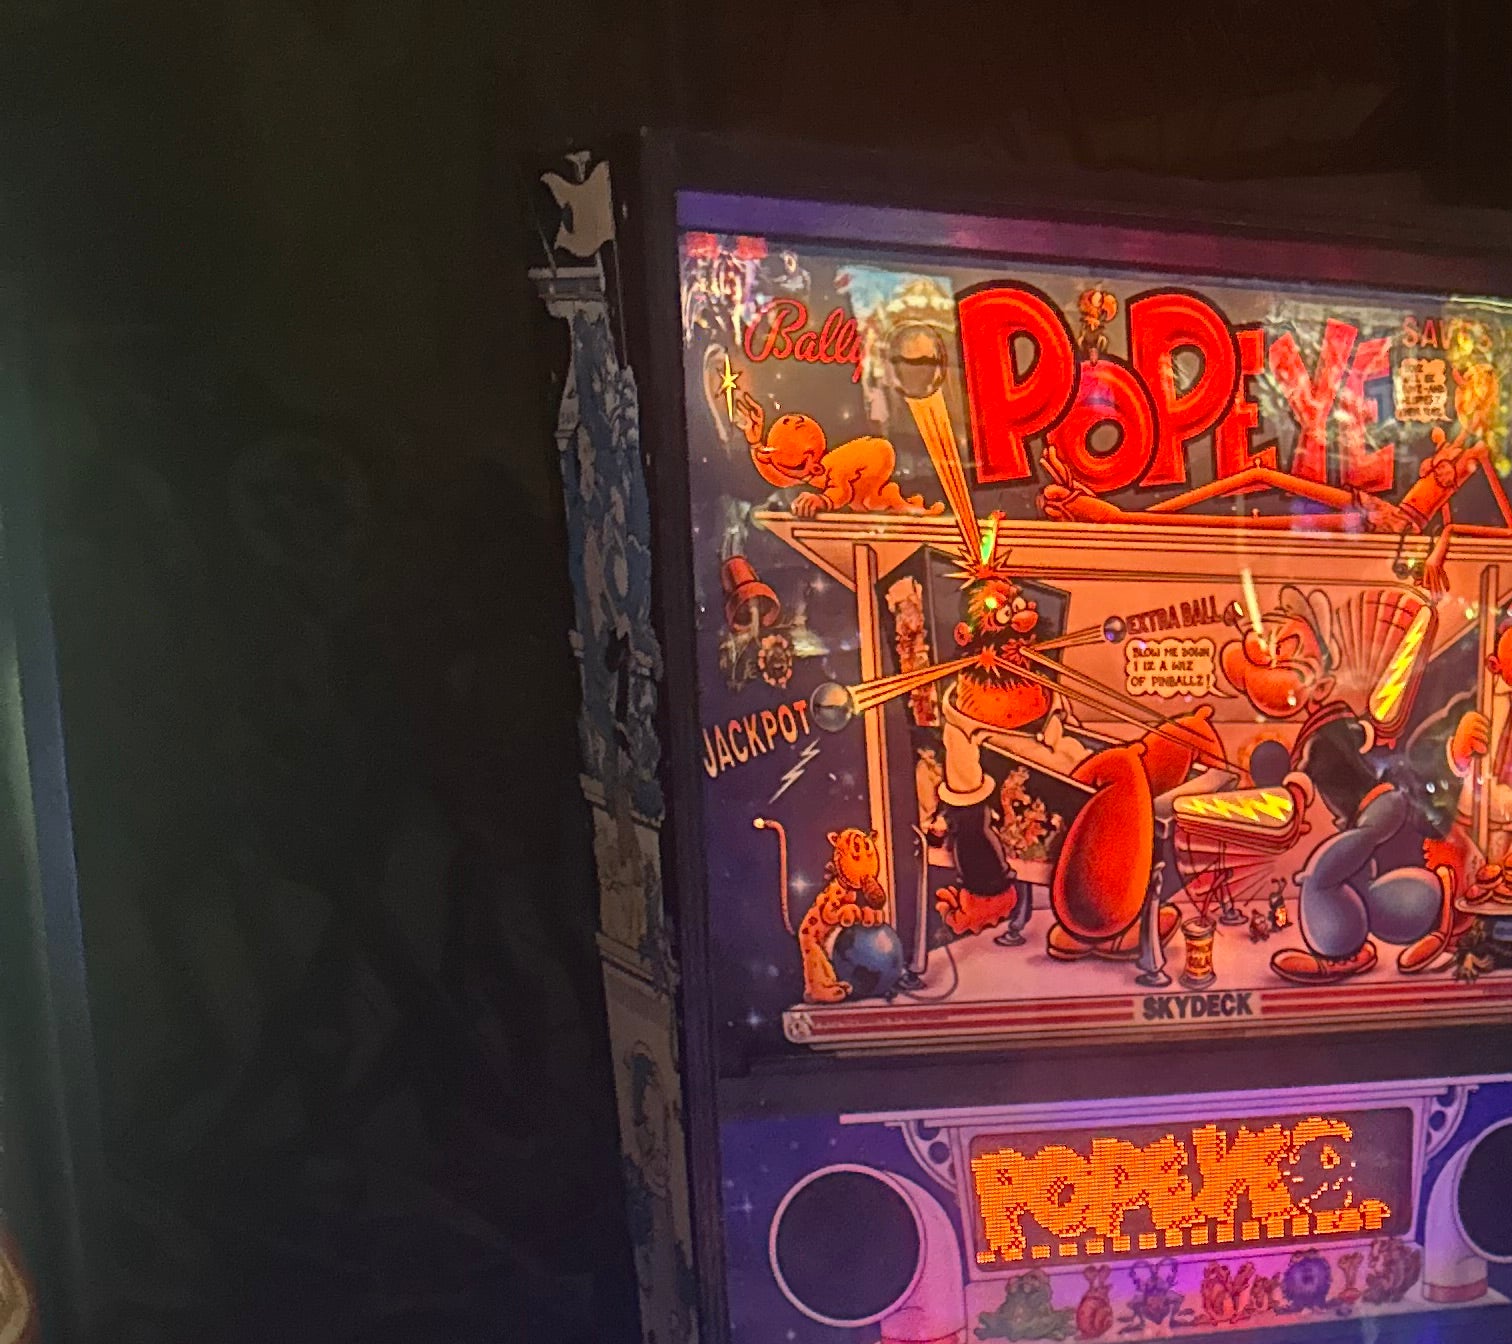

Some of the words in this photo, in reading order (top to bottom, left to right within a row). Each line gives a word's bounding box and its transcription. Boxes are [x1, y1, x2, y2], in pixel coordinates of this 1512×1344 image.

[745, 298, 878, 383] Bally
[957, 280, 1396, 493] POPEYE
[1126, 607, 1181, 635] EXTRA
[1180, 595, 1221, 627] BALL
[1132, 648, 1160, 658] BLOW
[1164, 648, 1178, 657] ME
[1181, 648, 1210, 657] DOWN
[1130, 676, 1146, 687] OF
[701, 699, 812, 779] JACKPOT
[1142, 991, 1254, 1021] SKYDECK
